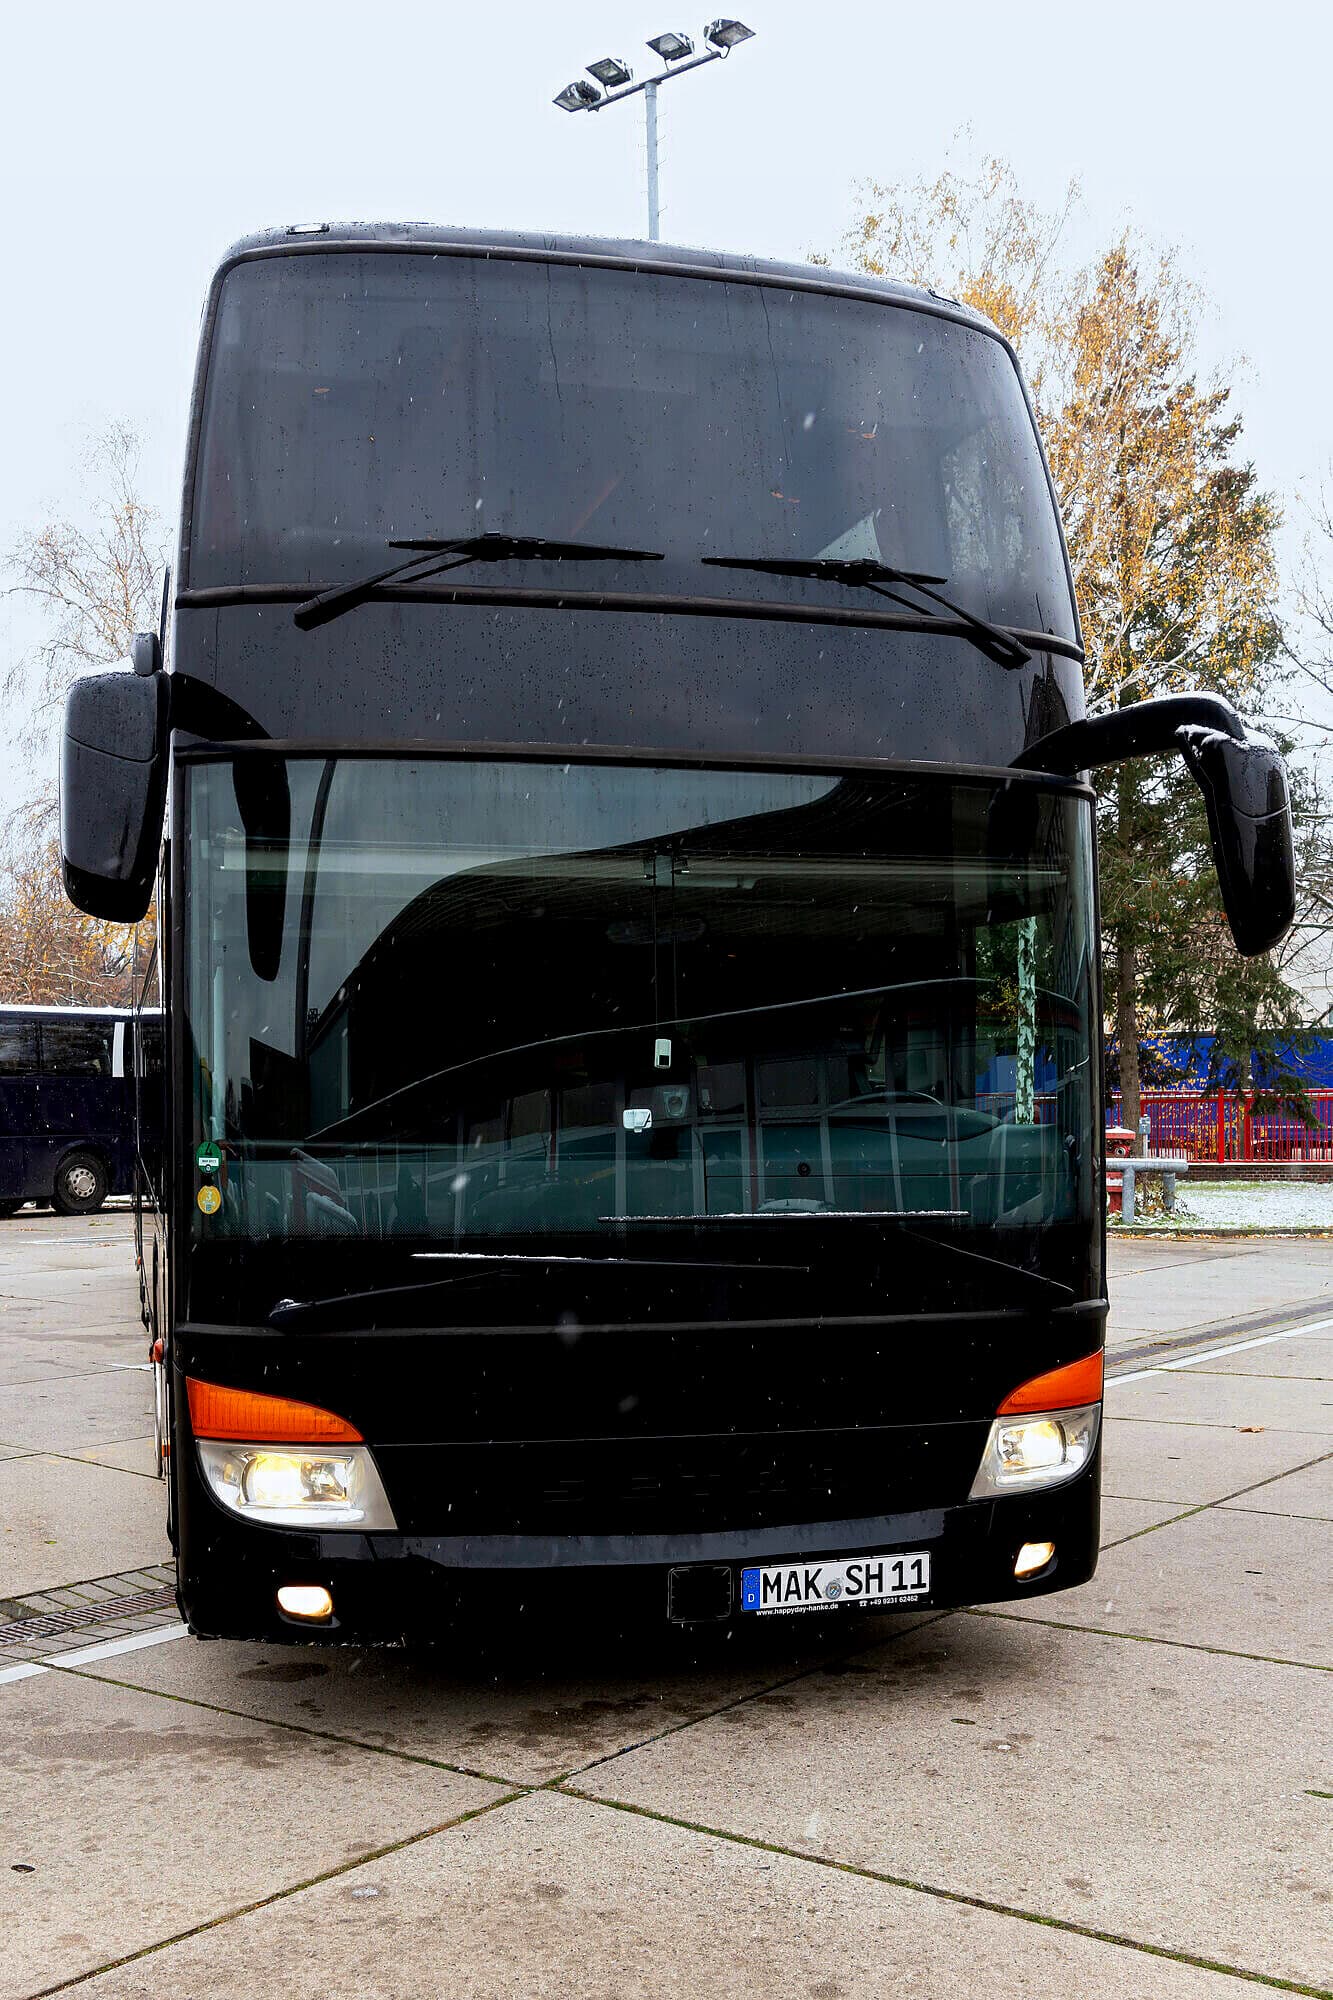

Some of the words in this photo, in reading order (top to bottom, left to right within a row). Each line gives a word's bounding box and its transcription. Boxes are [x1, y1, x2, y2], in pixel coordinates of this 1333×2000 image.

[762, 1567, 823, 1604] MAK
[845, 1562, 884, 1596] SH
[891, 1558, 927, 1592] 11
[747, 1593, 755, 1603] D
[756, 1602, 839, 1616] www.happyday-hanke.de
[870, 1598, 882, 1606] +49
